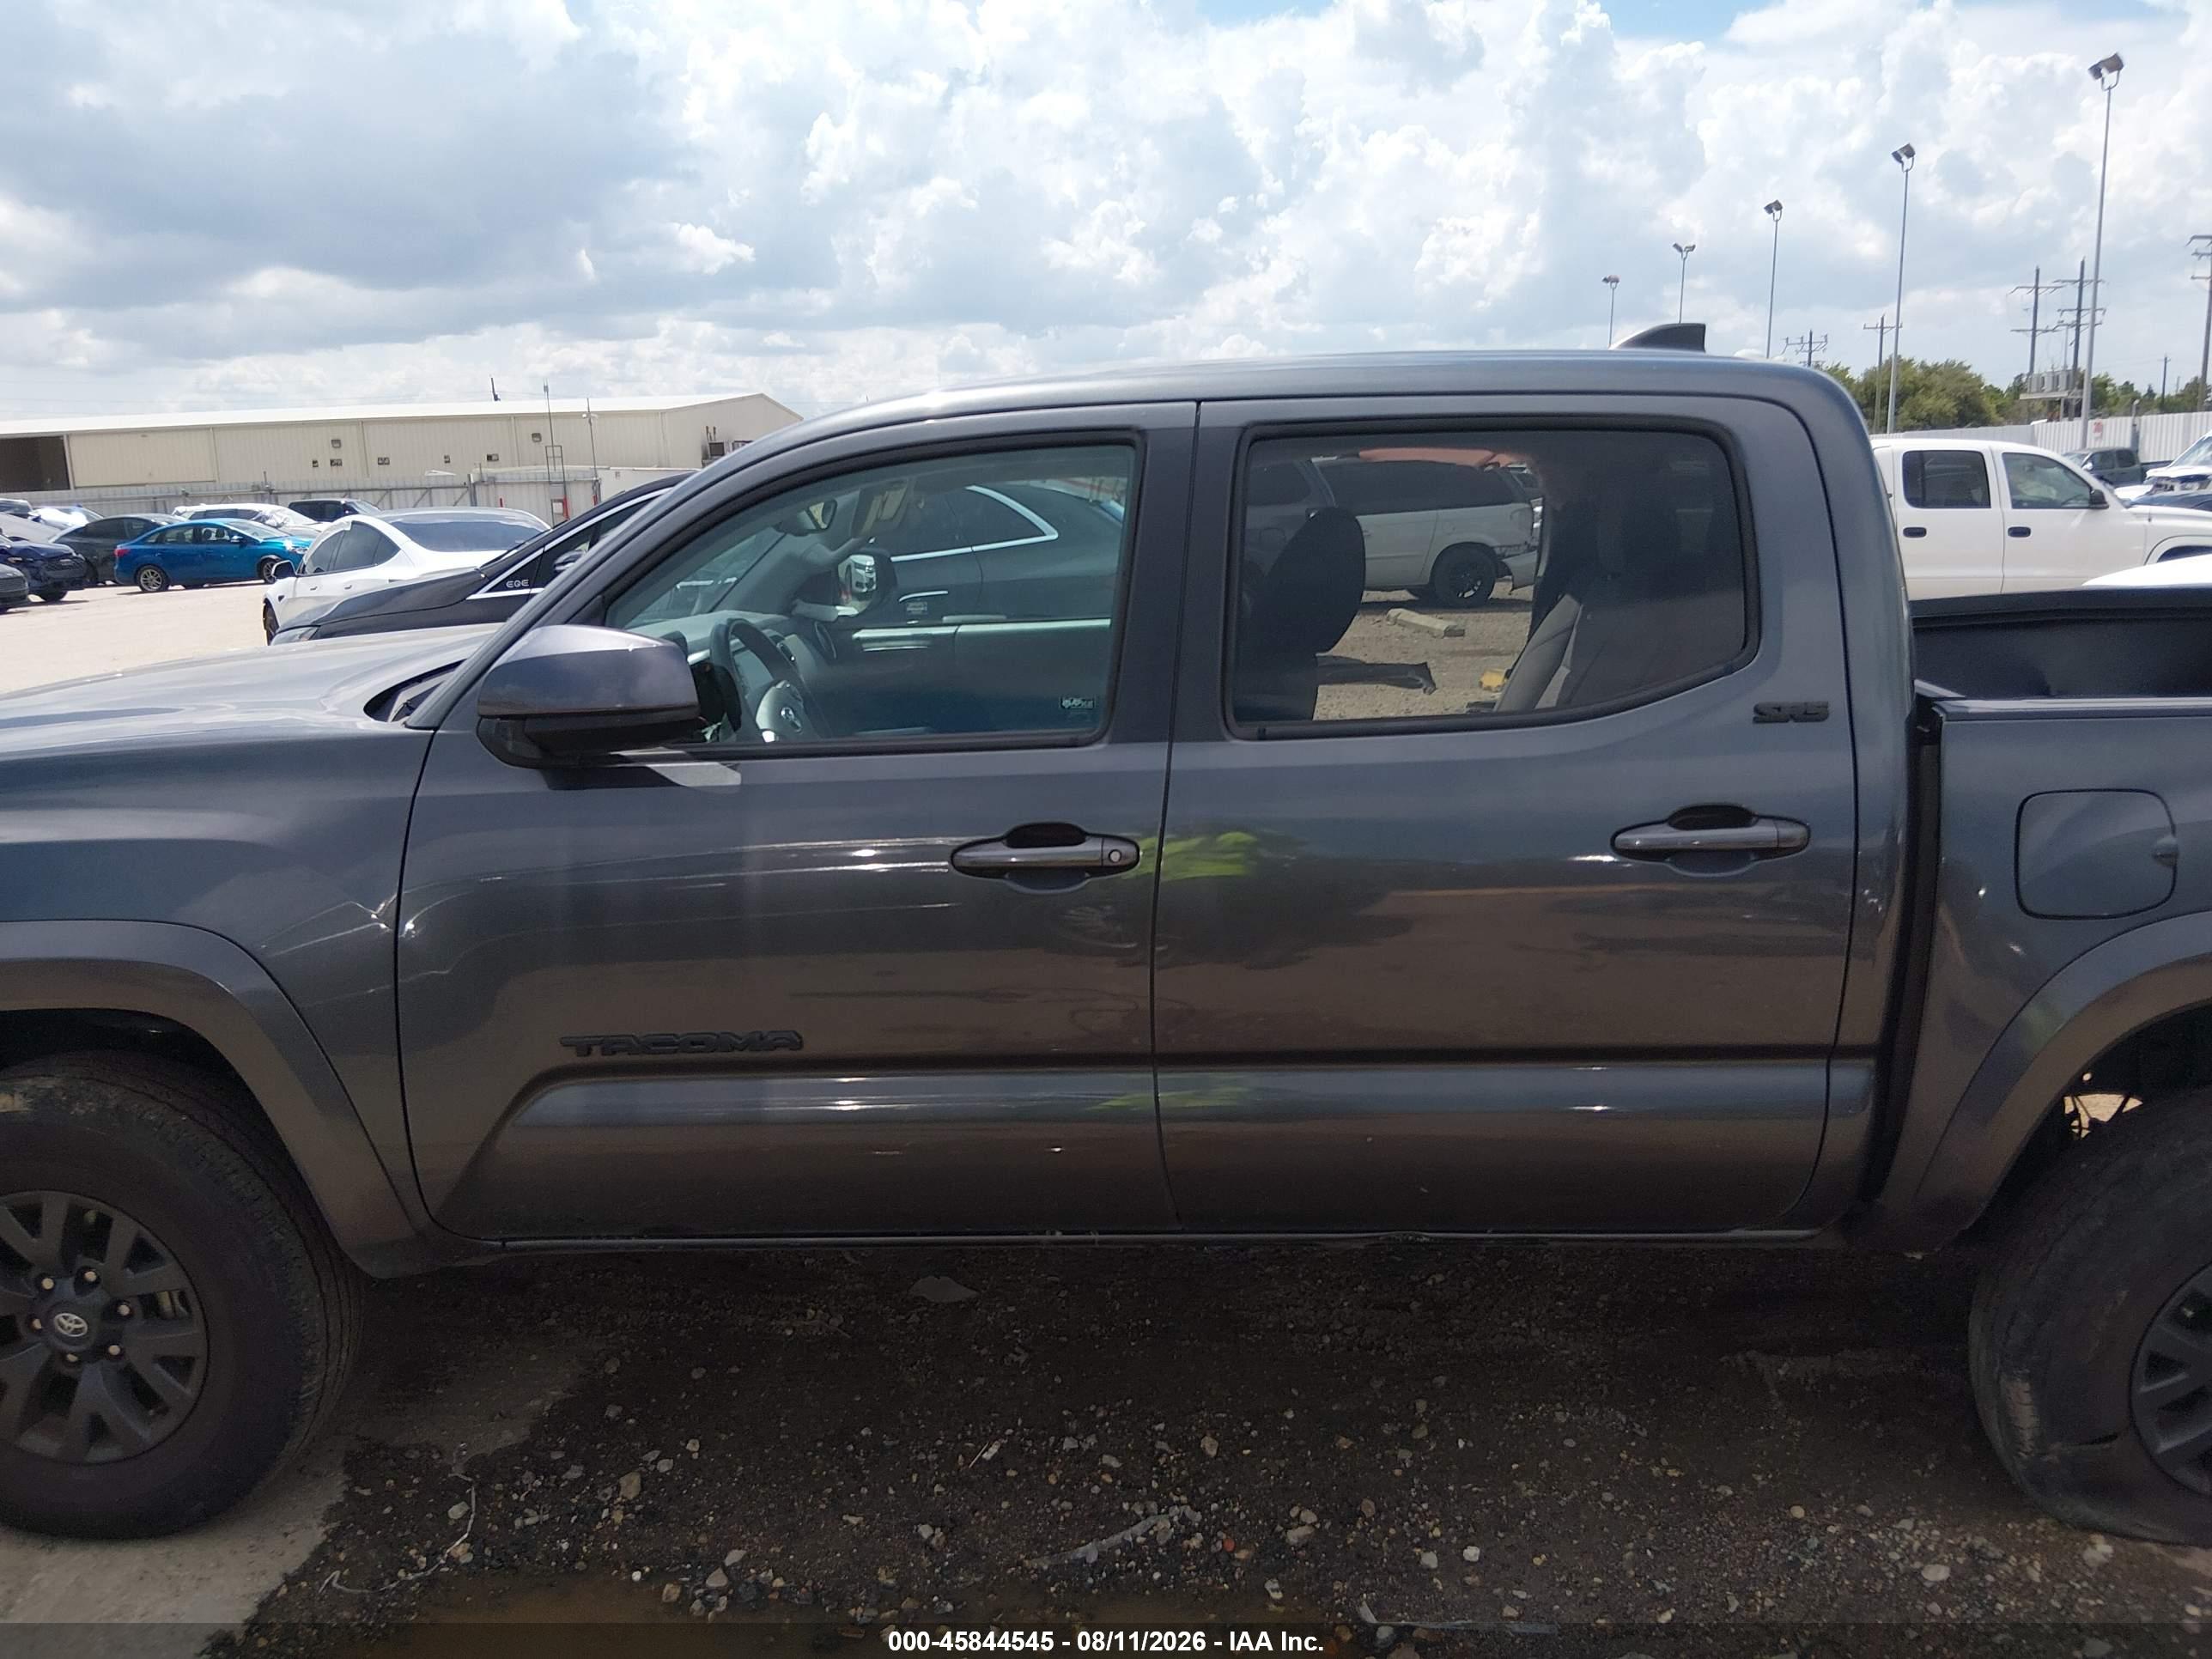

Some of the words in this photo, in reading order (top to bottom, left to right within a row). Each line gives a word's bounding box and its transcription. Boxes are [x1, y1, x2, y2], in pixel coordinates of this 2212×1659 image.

[506, 579, 530, 588] EQE
[1753, 701, 1829, 723] SR5
[559, 1030, 804, 1057] TACOMA
